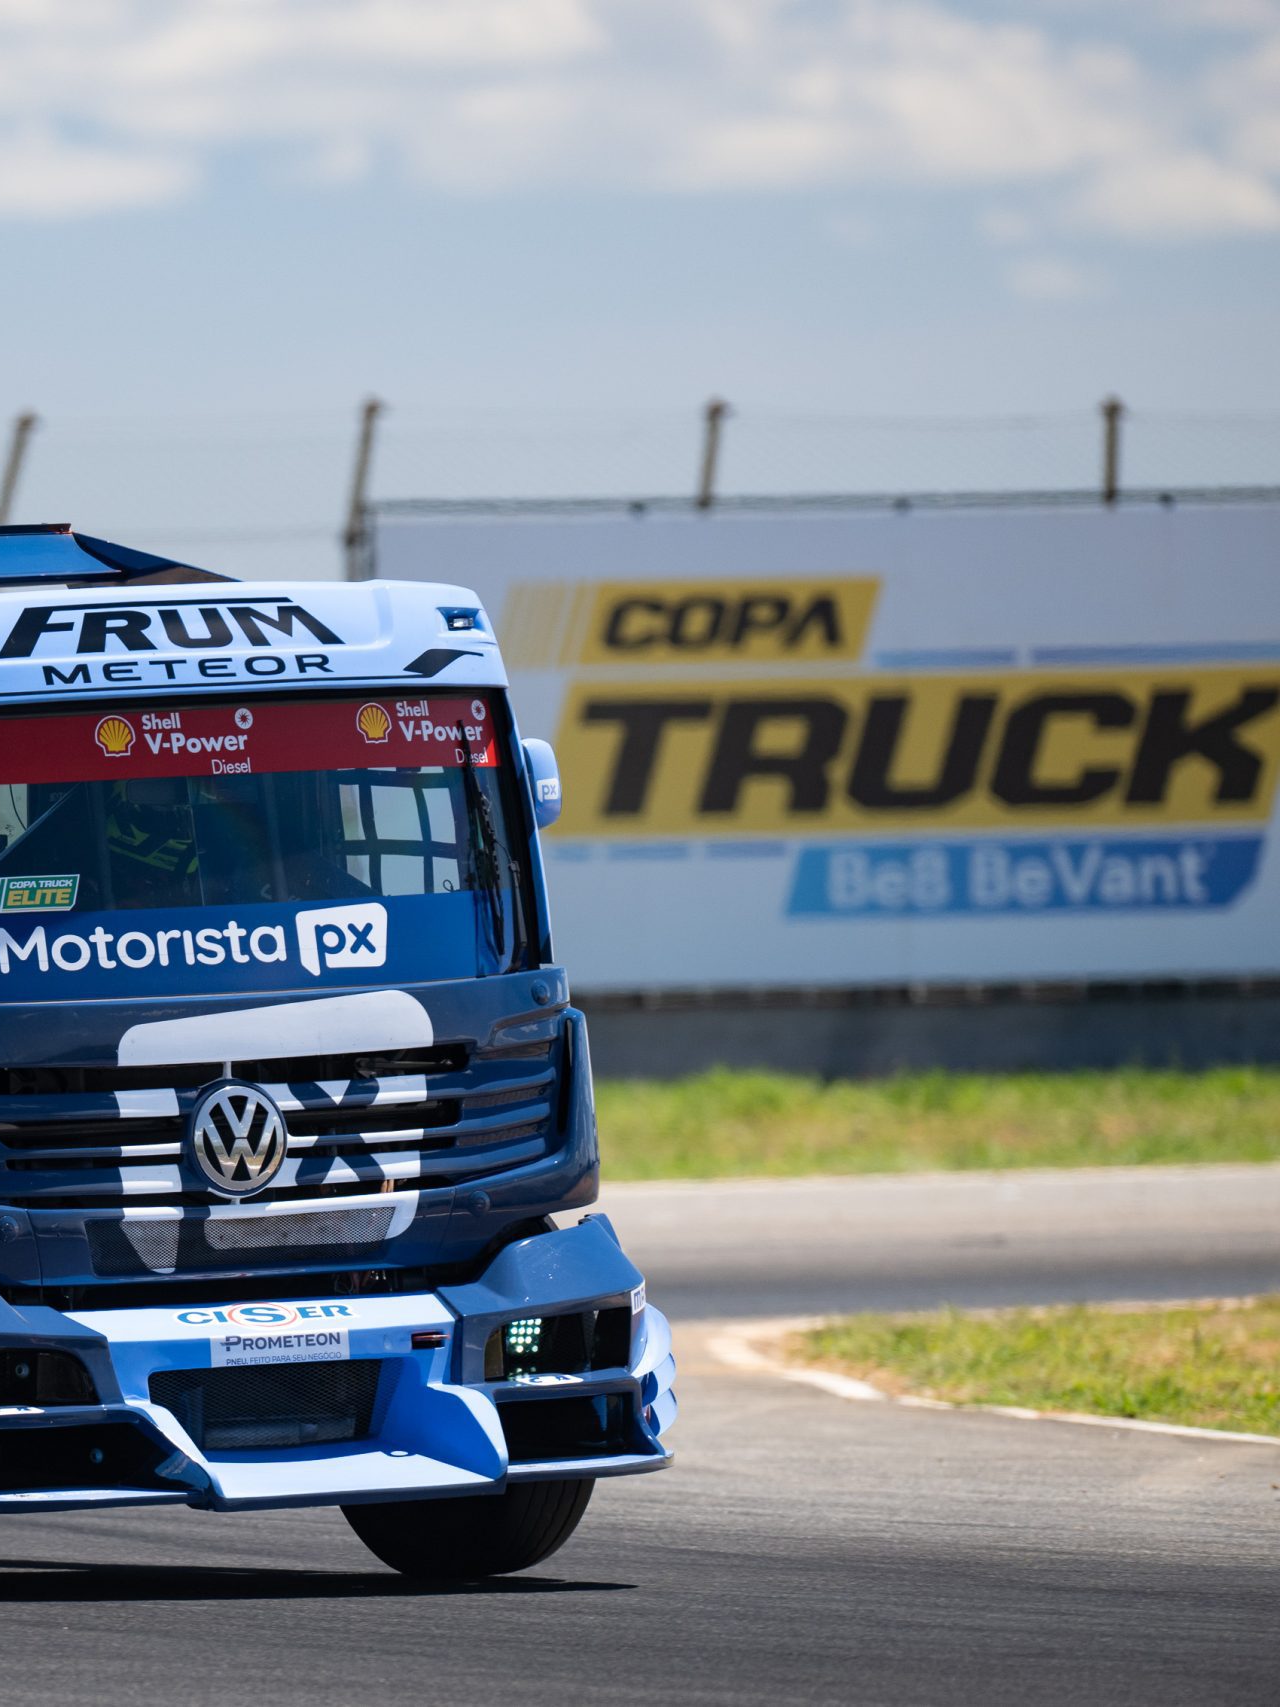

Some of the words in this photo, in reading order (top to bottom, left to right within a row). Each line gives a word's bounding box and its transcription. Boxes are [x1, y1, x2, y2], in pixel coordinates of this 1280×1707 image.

[604, 590, 845, 651] COPA
[42, 654, 335, 686] METEOR
[396, 699, 429, 717] Shell
[141, 712, 182, 730] Shell
[399, 720, 483, 742] V-Power
[144, 732, 248, 755] V-Power
[581, 684, 1280, 818] TRUCK
[211, 757, 252, 775] Diesel
[455, 747, 489, 764] Desel
[542, 783, 557, 799] px
[9, 880, 37, 889] COPA
[38, 879, 73, 888] TRUCK
[968, 842, 1209, 905] BeVant
[6, 888, 72, 906] ELITE
[314, 921, 377, 968] px
[177, 1303, 353, 1325] CISER
[220, 1331, 341, 1352] PROMETEON
[250, 1356, 271, 1365] FEITO
[272, 1355, 292, 1363] PARA
[293, 1354, 307, 1362] SEU
